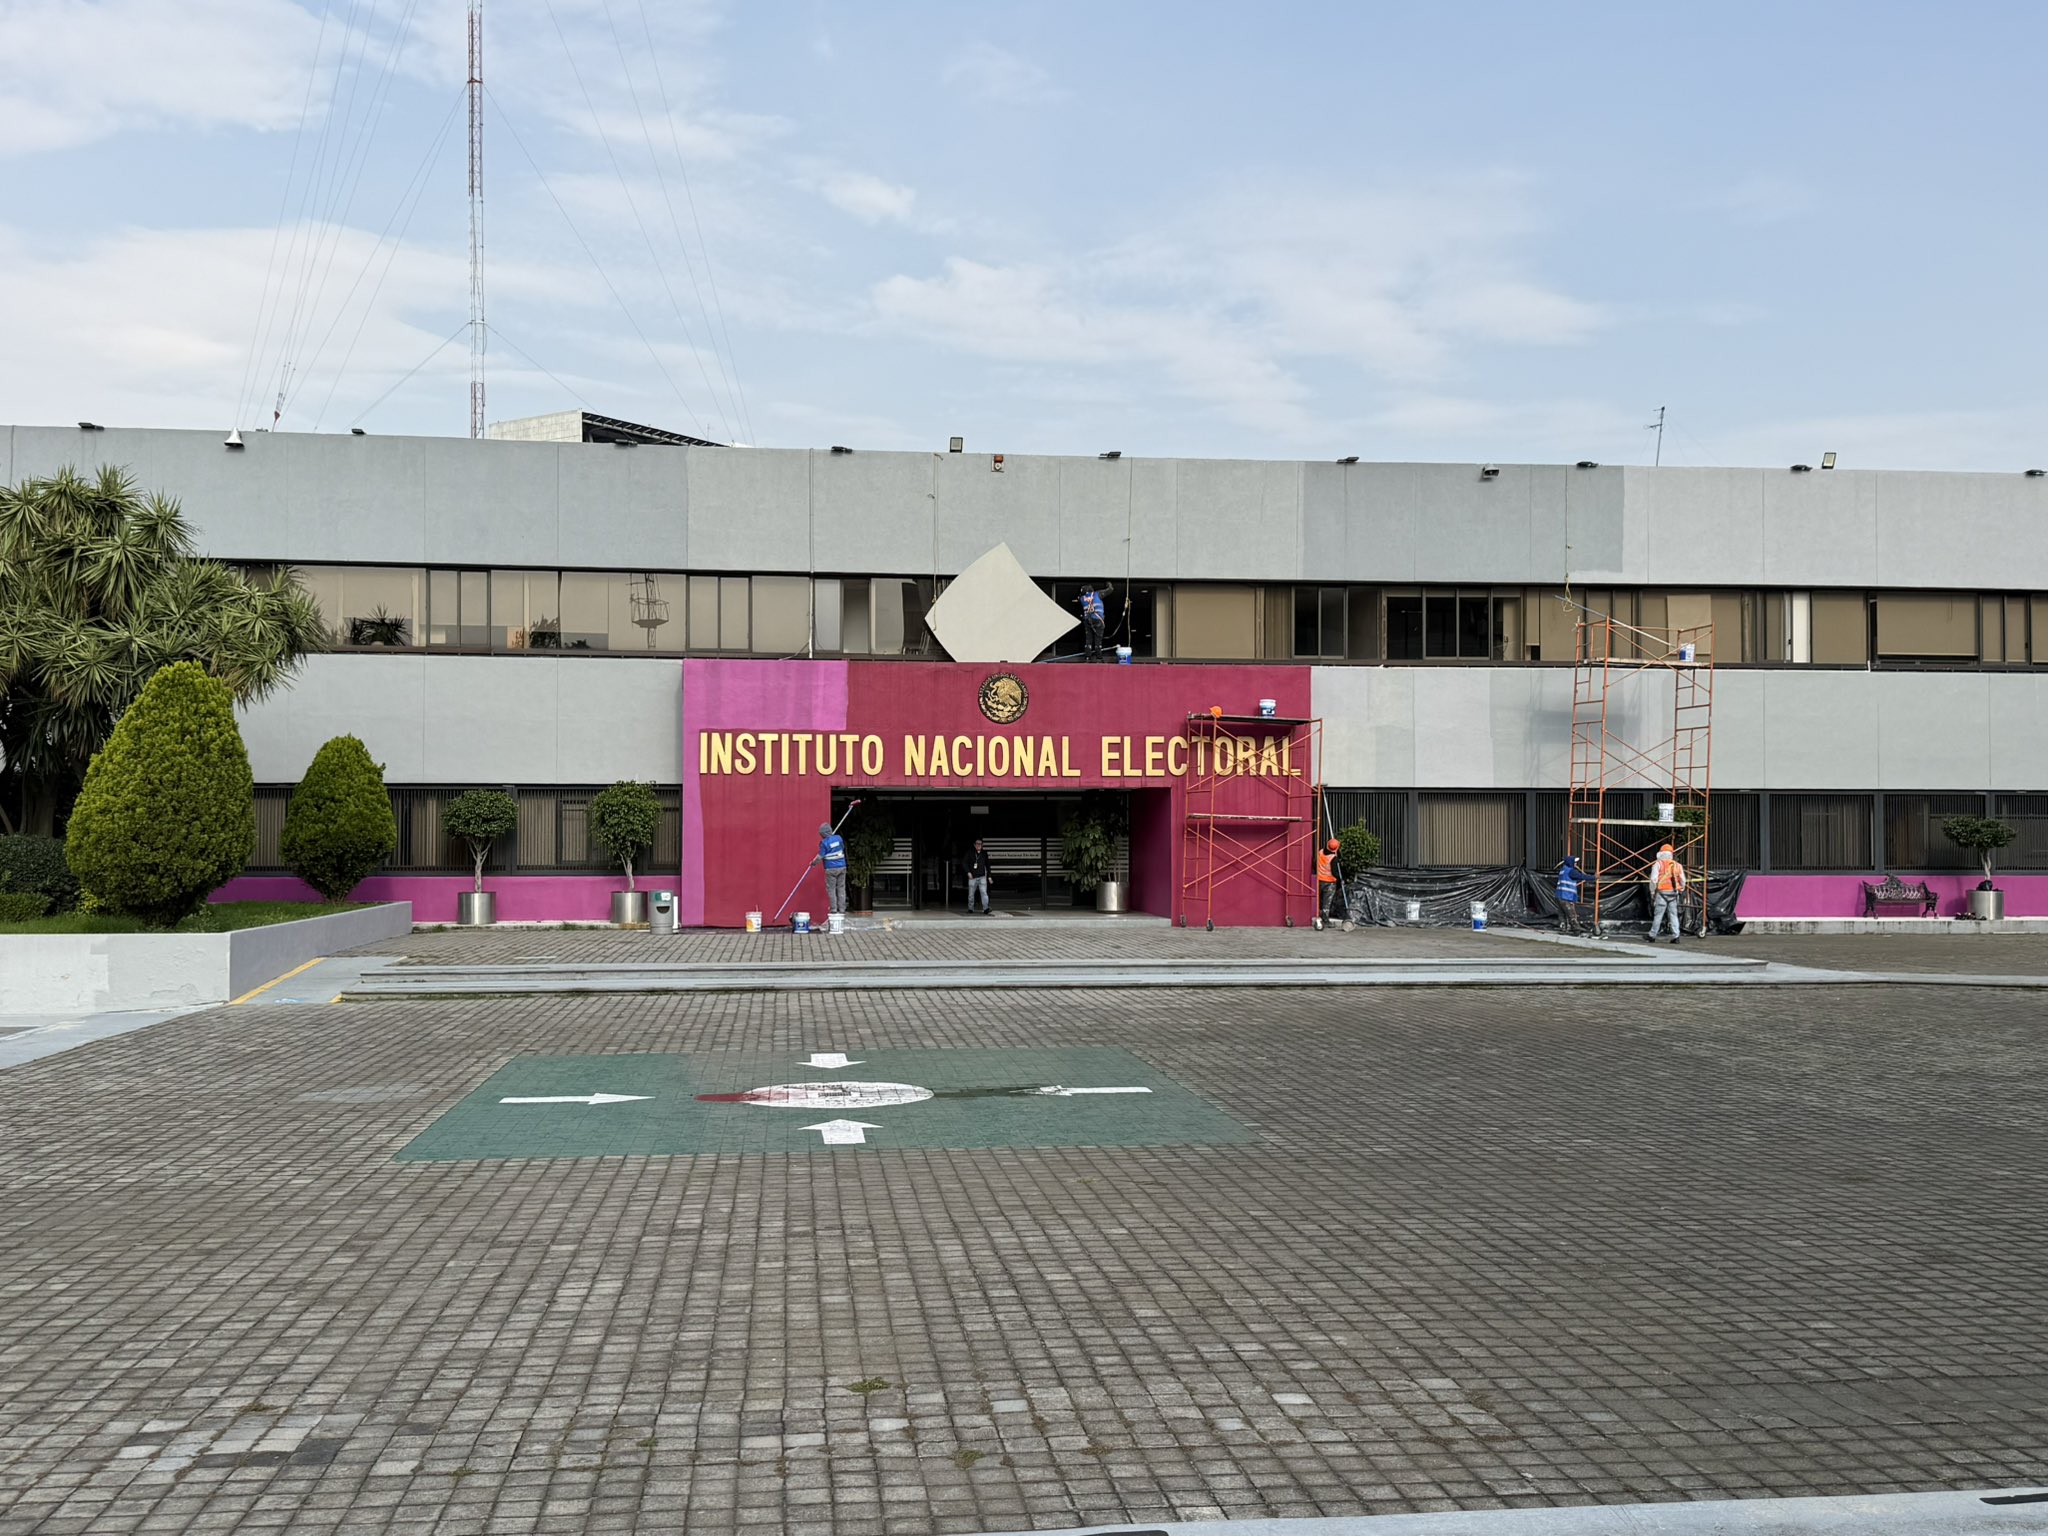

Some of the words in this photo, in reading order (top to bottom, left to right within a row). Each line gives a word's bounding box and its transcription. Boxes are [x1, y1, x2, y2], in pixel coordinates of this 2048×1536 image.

[699, 732, 884, 776] INSTITUTO
[904, 735, 1081, 777] NACIONAL
[1101, 735, 1302, 777] ELECTORAL
